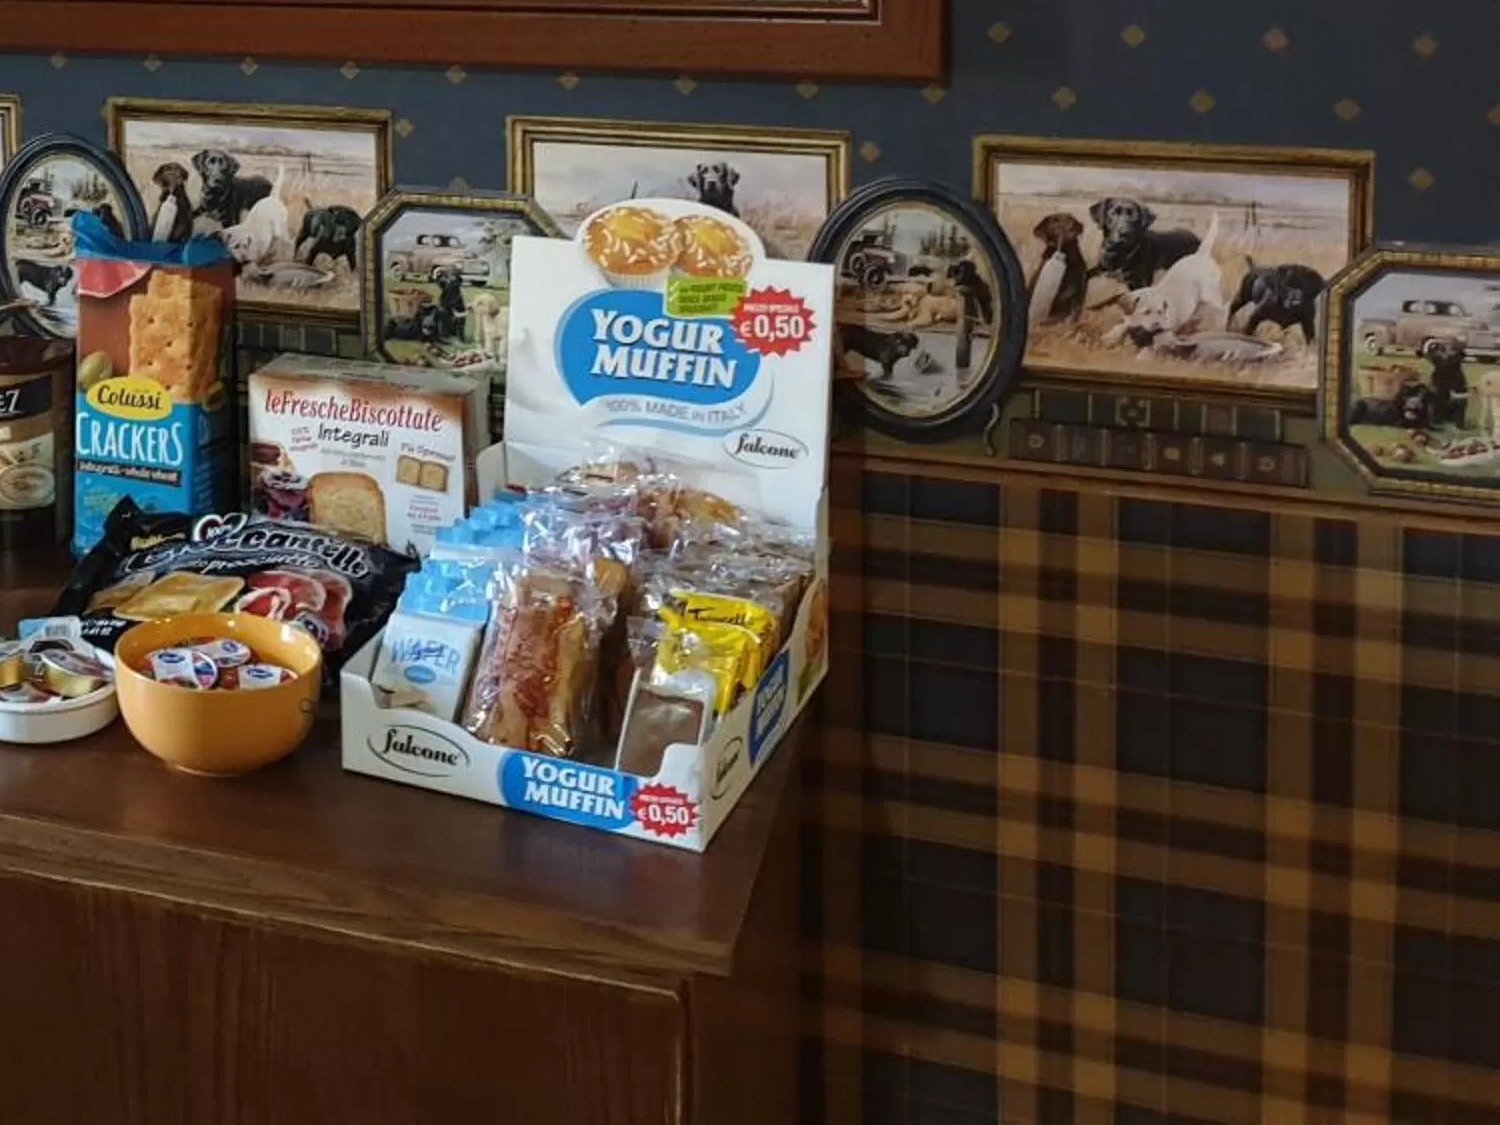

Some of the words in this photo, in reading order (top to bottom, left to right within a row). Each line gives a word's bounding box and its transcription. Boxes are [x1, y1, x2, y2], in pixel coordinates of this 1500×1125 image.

[591, 308, 725, 354] YOGUR
[590, 343, 739, 389] MUFFIN
[97, 384, 163, 410] Colussi
[645, 401, 689, 420] MADE
[707, 402, 748, 423] ITALY
[76, 411, 184, 466] CRACKERS
[317, 423, 390, 448] Integrali
[735, 432, 801, 460] falcone
[381, 728, 461, 766] falcone
[521, 756, 616, 796] YOGUR
[524, 781, 626, 820] MUFFIN
